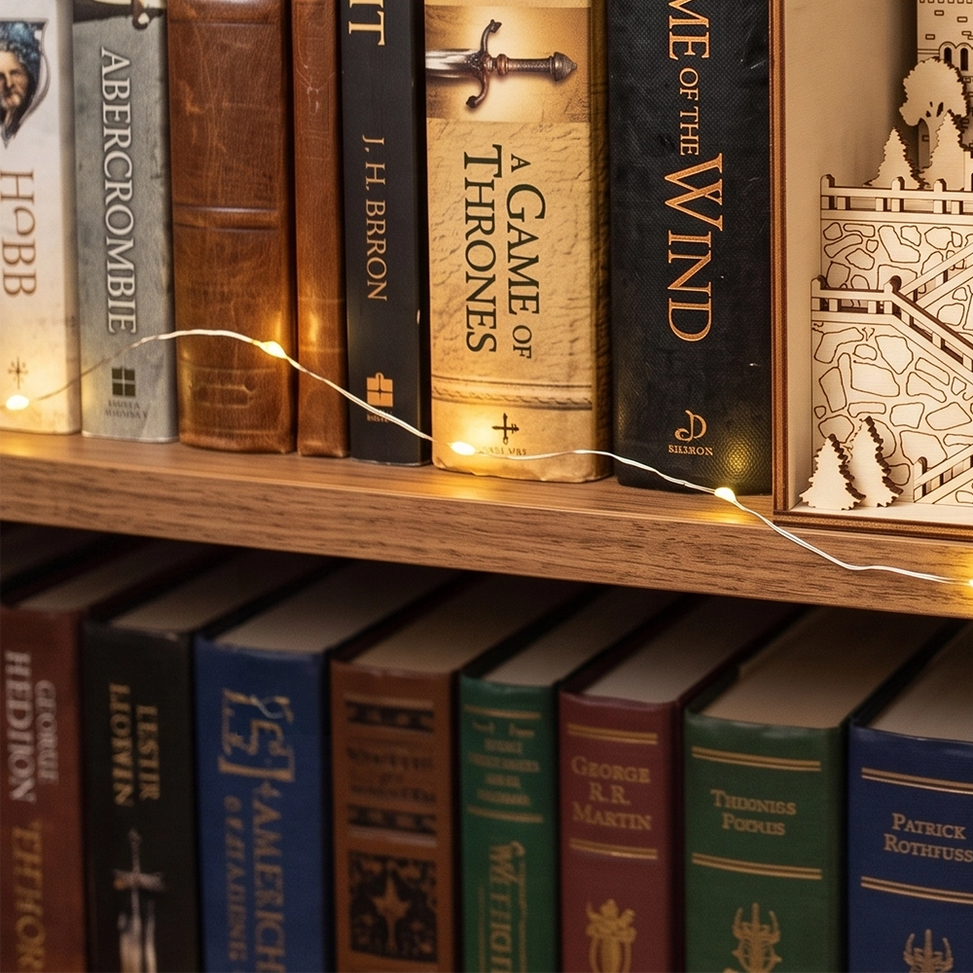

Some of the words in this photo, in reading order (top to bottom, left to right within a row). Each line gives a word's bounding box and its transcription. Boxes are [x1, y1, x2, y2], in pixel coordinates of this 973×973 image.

[679, 67, 699, 101] OF
[680, 106, 699, 156] THE
[511, 153, 531, 173] A
[100, 47, 137, 334] ABERCROMBIE
[365, 198, 388, 301] BRRON
[463, 144, 503, 353] THRONES
[506, 183, 546, 316] GAME
[664, 152, 723, 342] WIND
[512, 325, 533, 359] OF
[571, 755, 651, 784] GEORGE
[572, 801, 652, 831] MARTIN
[892, 812, 967, 840] PATRICK
